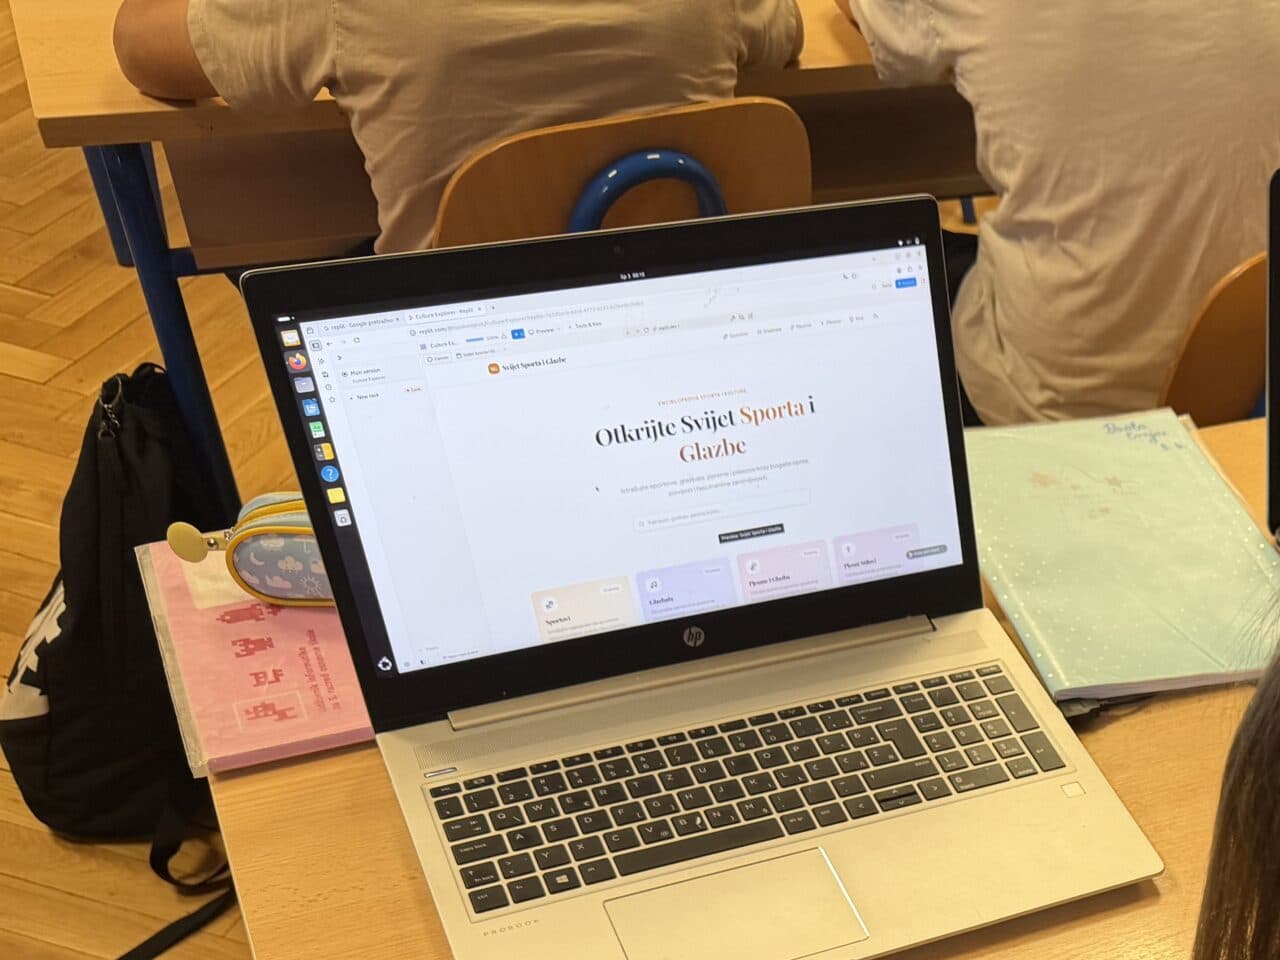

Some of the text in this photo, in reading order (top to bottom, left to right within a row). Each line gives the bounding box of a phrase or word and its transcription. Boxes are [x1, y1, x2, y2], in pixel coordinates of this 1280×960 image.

[595, 394, 816, 448] Otkrijte Svijet Sporta i
[679, 438, 747, 463] Glazbe
[684, 626, 704, 647] hp
